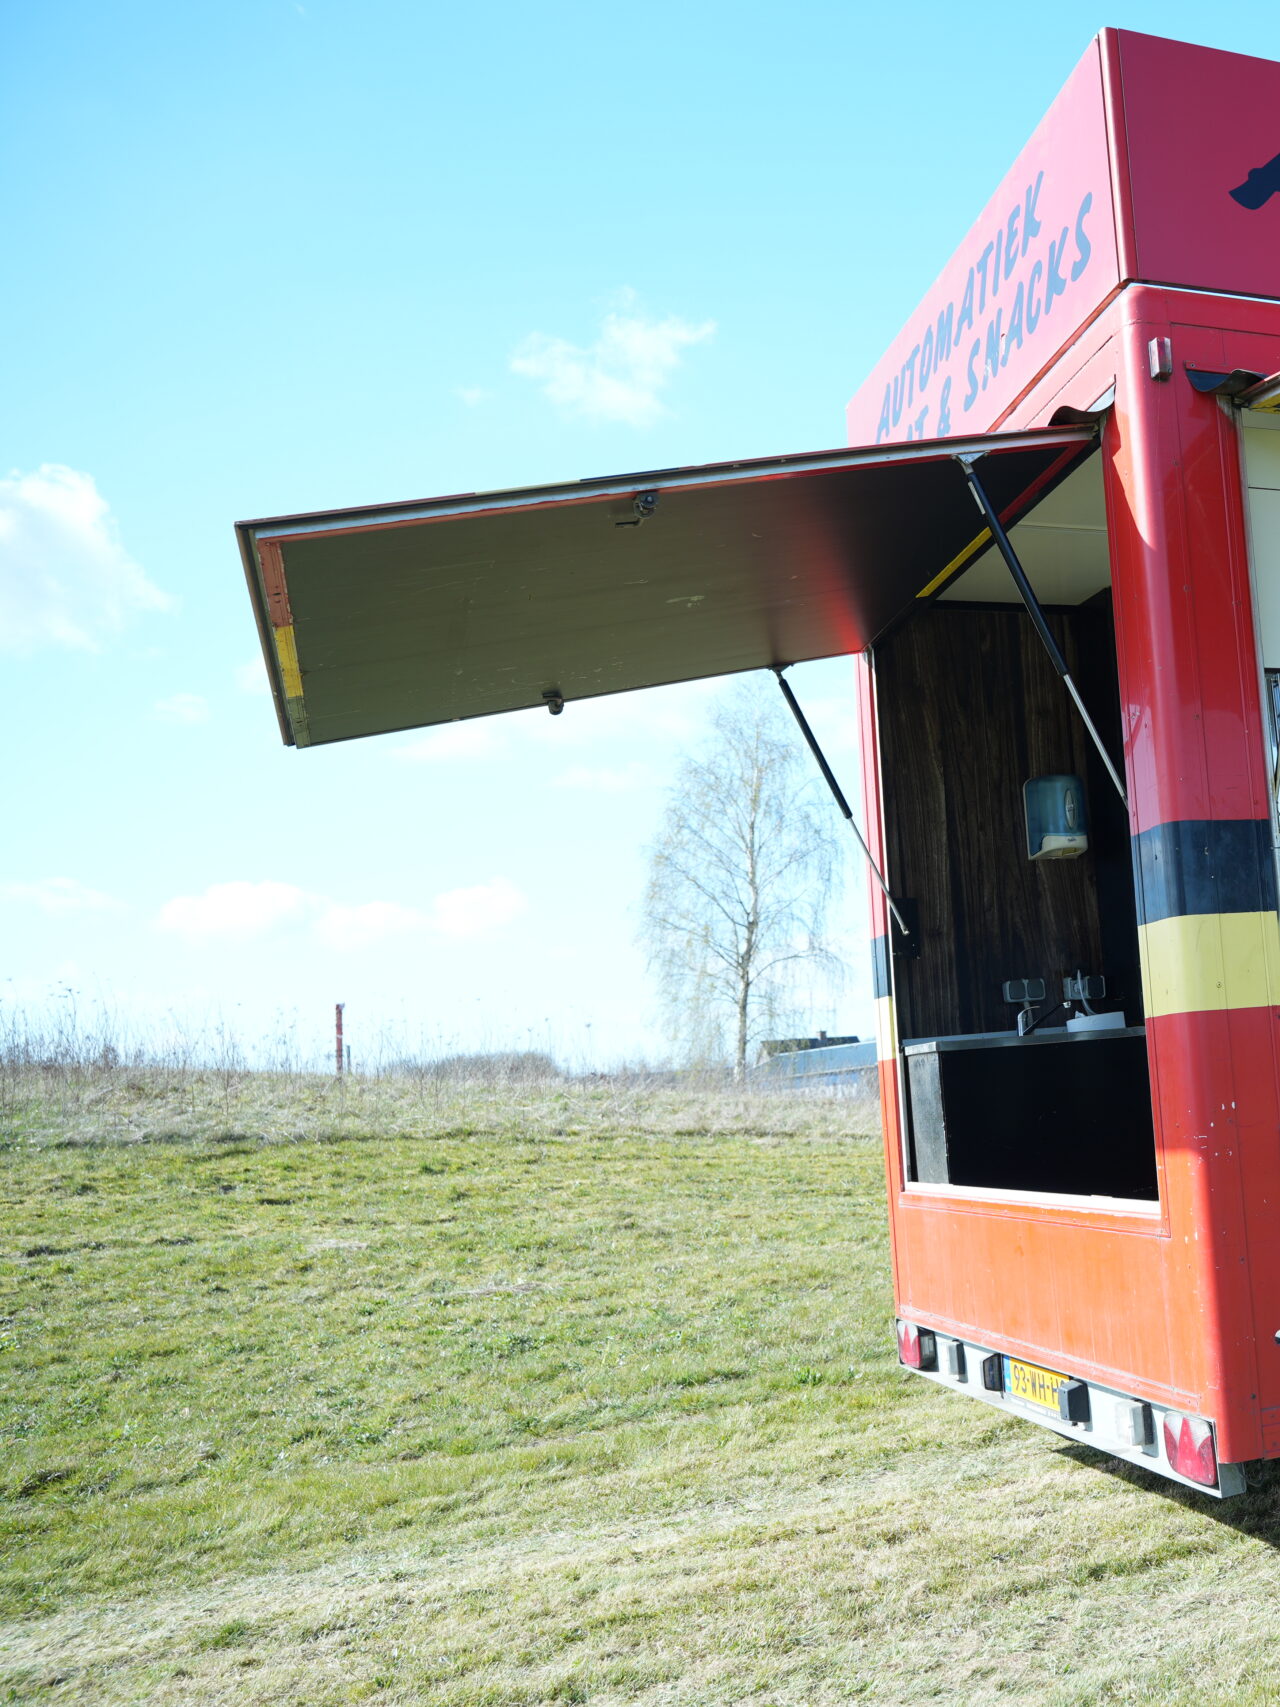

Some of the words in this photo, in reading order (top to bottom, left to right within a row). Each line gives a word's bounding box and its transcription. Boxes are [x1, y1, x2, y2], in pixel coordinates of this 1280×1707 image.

[875, 170, 1045, 444] AUTOMATIEK
[937, 373, 952, 437] &
[963, 191, 1093, 413] SNACKS
[1013, 1364, 1065, 1405] 93-WH-H
